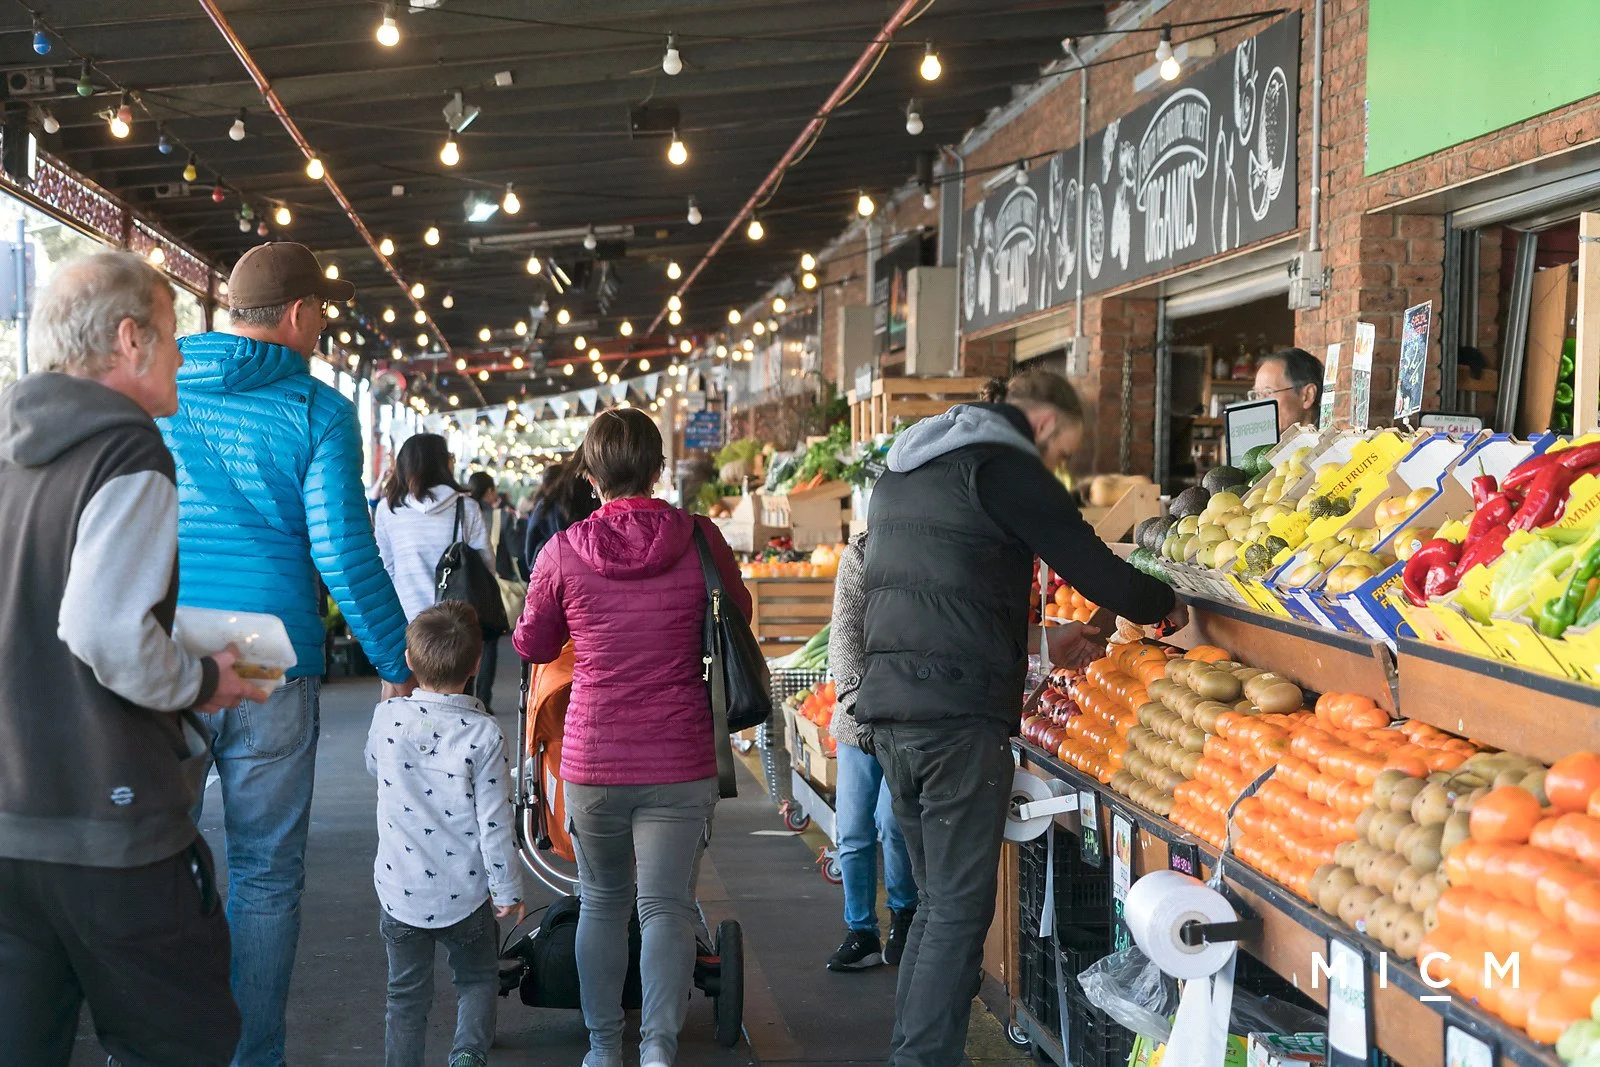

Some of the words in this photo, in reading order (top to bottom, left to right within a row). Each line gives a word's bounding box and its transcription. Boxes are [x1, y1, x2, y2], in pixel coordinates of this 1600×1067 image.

[1144, 160, 1198, 263] ORGANICS
[1447, 424, 1475, 433] CHILLI
[1345, 453, 1379, 484] FRUITS
[1371, 573, 1402, 601] FRESH
